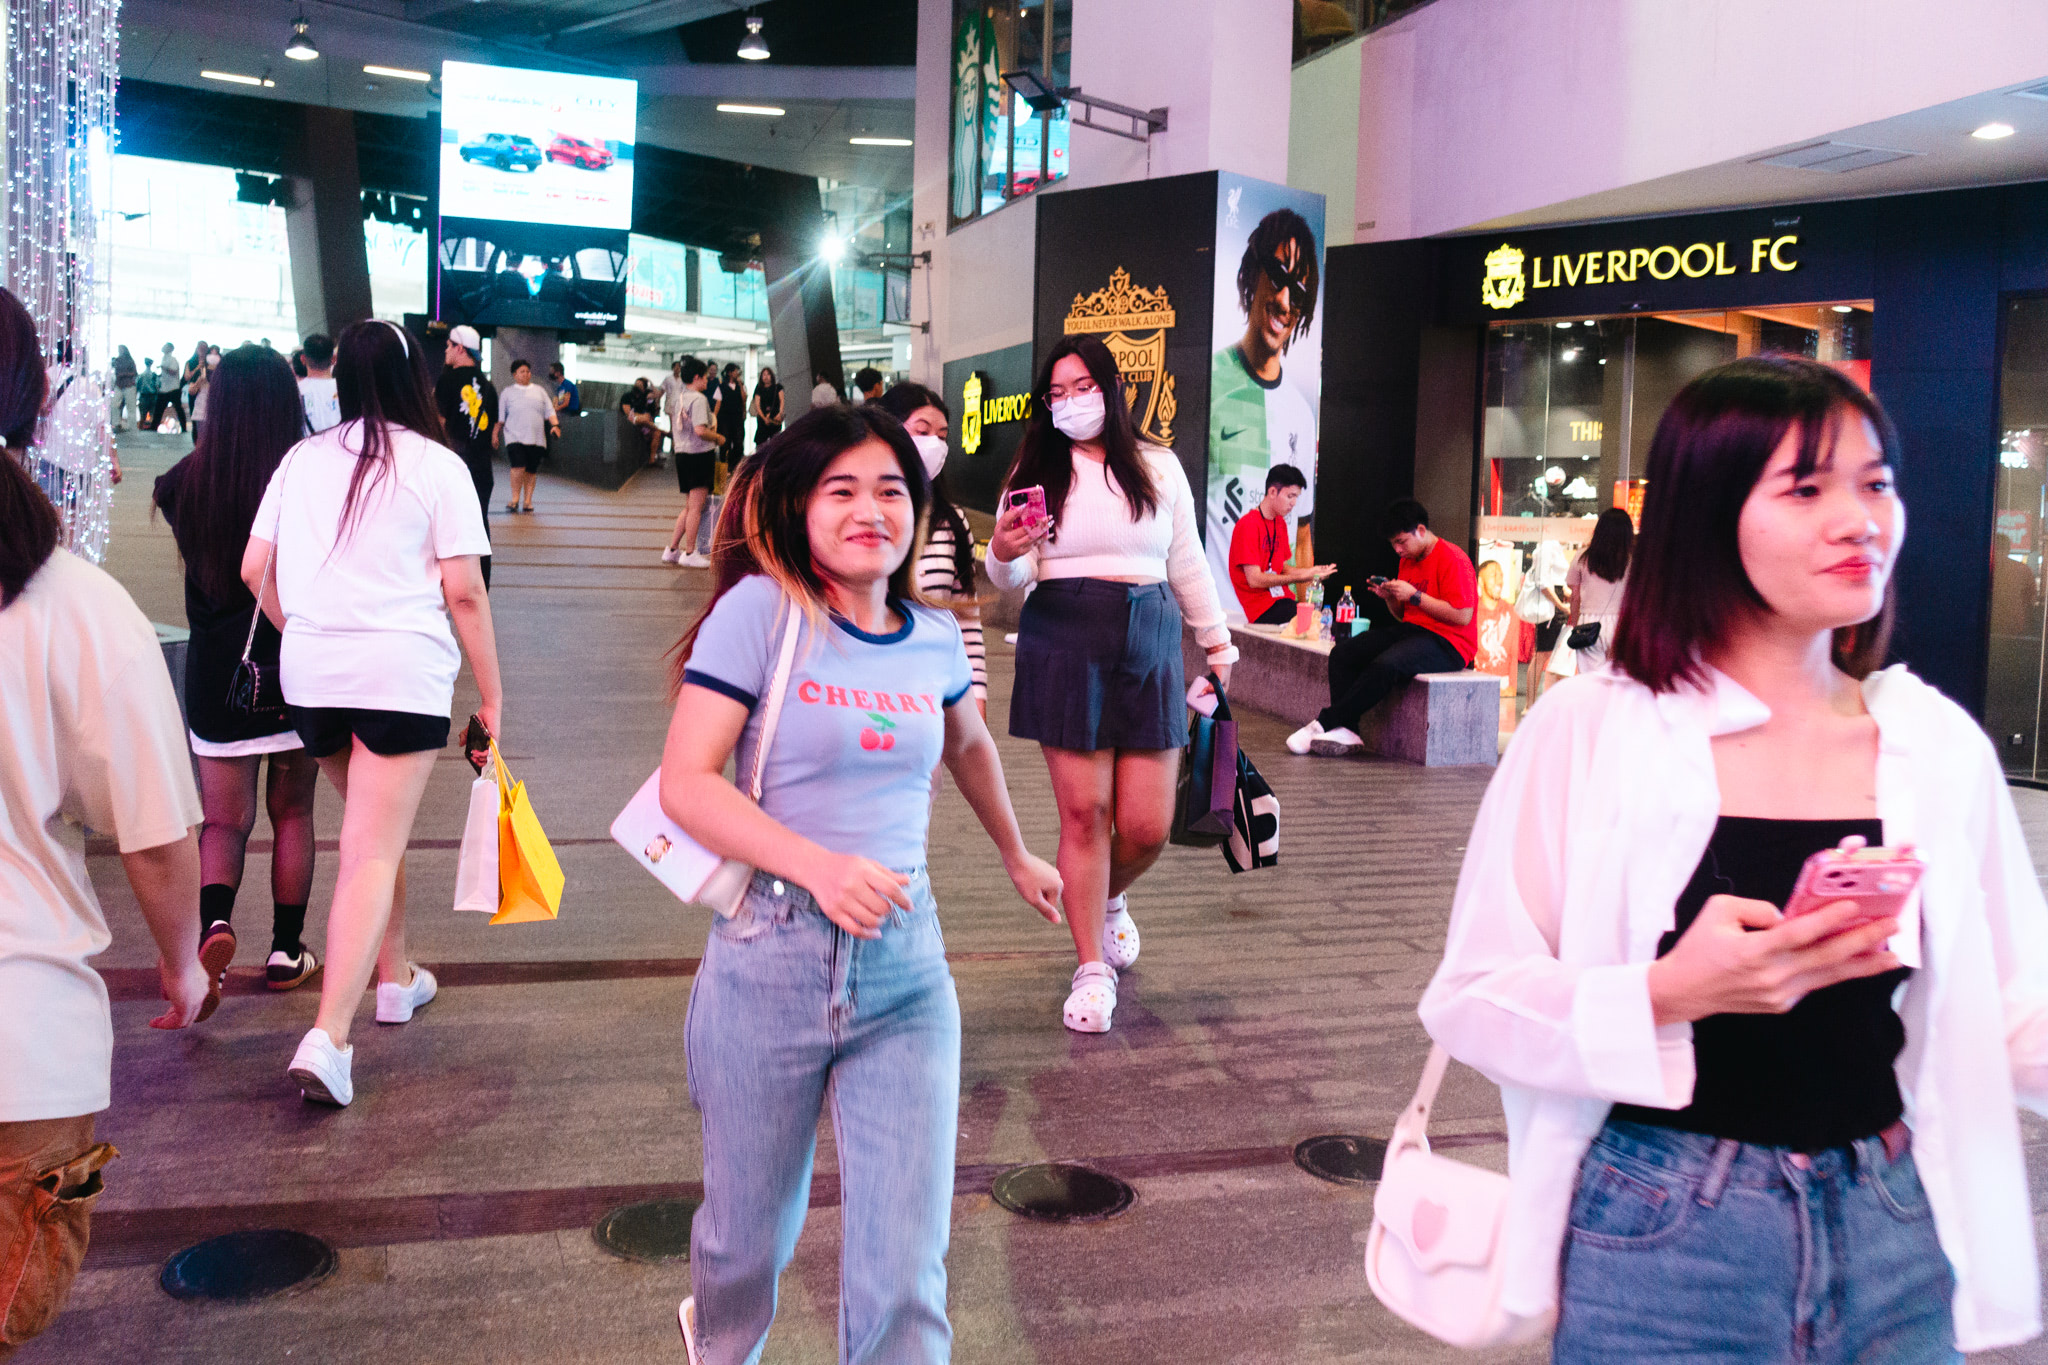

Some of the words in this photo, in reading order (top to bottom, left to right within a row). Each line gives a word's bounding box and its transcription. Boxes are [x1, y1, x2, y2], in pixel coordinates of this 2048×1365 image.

[1532, 241, 1737, 289] LIVERPOOL
[1751, 235, 1798, 273] FC
[1092, 317, 1118, 330] NEVER
[1119, 316, 1141, 328] WALK
[1142, 314, 1171, 326] ALONE
[1127, 371, 1153, 383] CLUB
[798, 679, 938, 715] CHERRY
